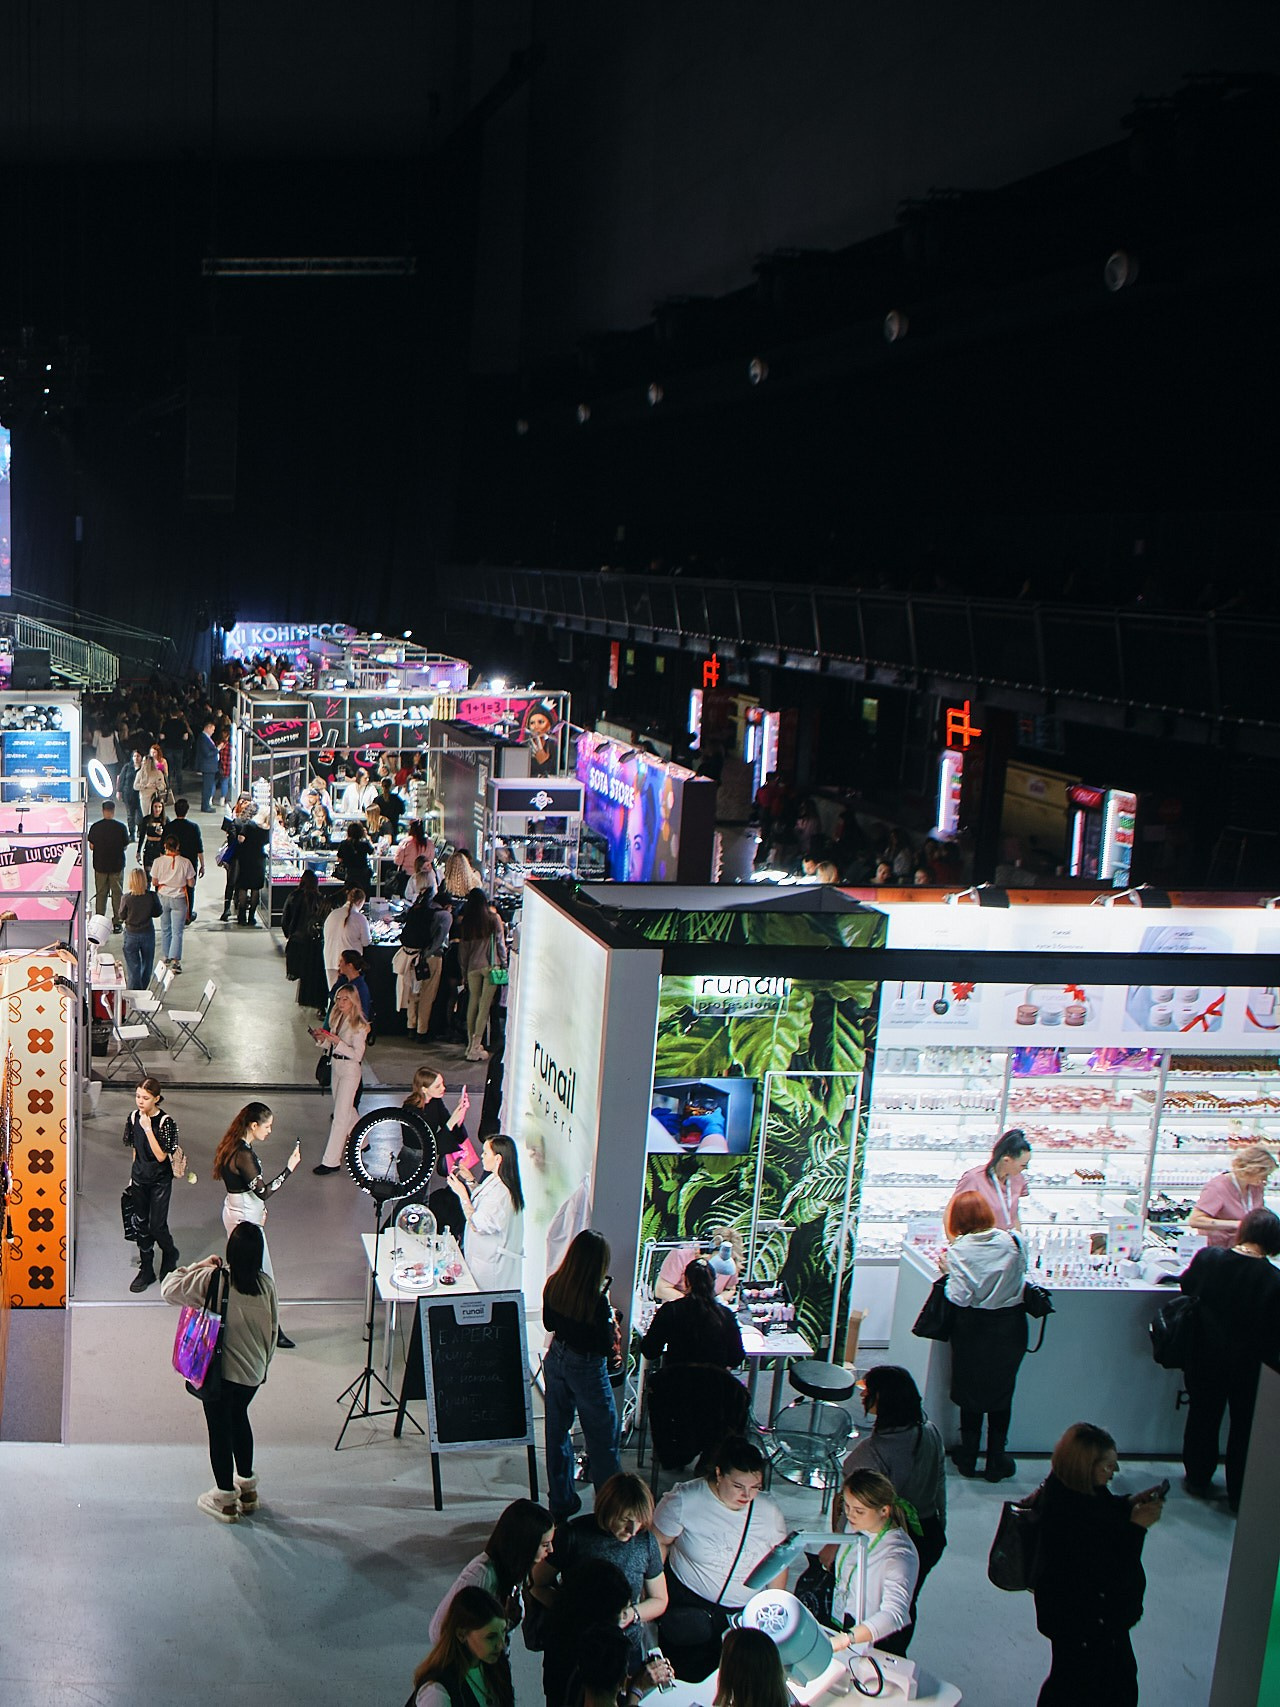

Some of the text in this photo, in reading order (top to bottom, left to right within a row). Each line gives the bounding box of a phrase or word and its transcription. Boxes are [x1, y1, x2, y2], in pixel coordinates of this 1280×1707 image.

[589, 767, 635, 809] SOTA STORE
[25, 848, 42, 862] LUI
[533, 1039, 576, 1114] runail
[531, 1082, 572, 1143] expert
